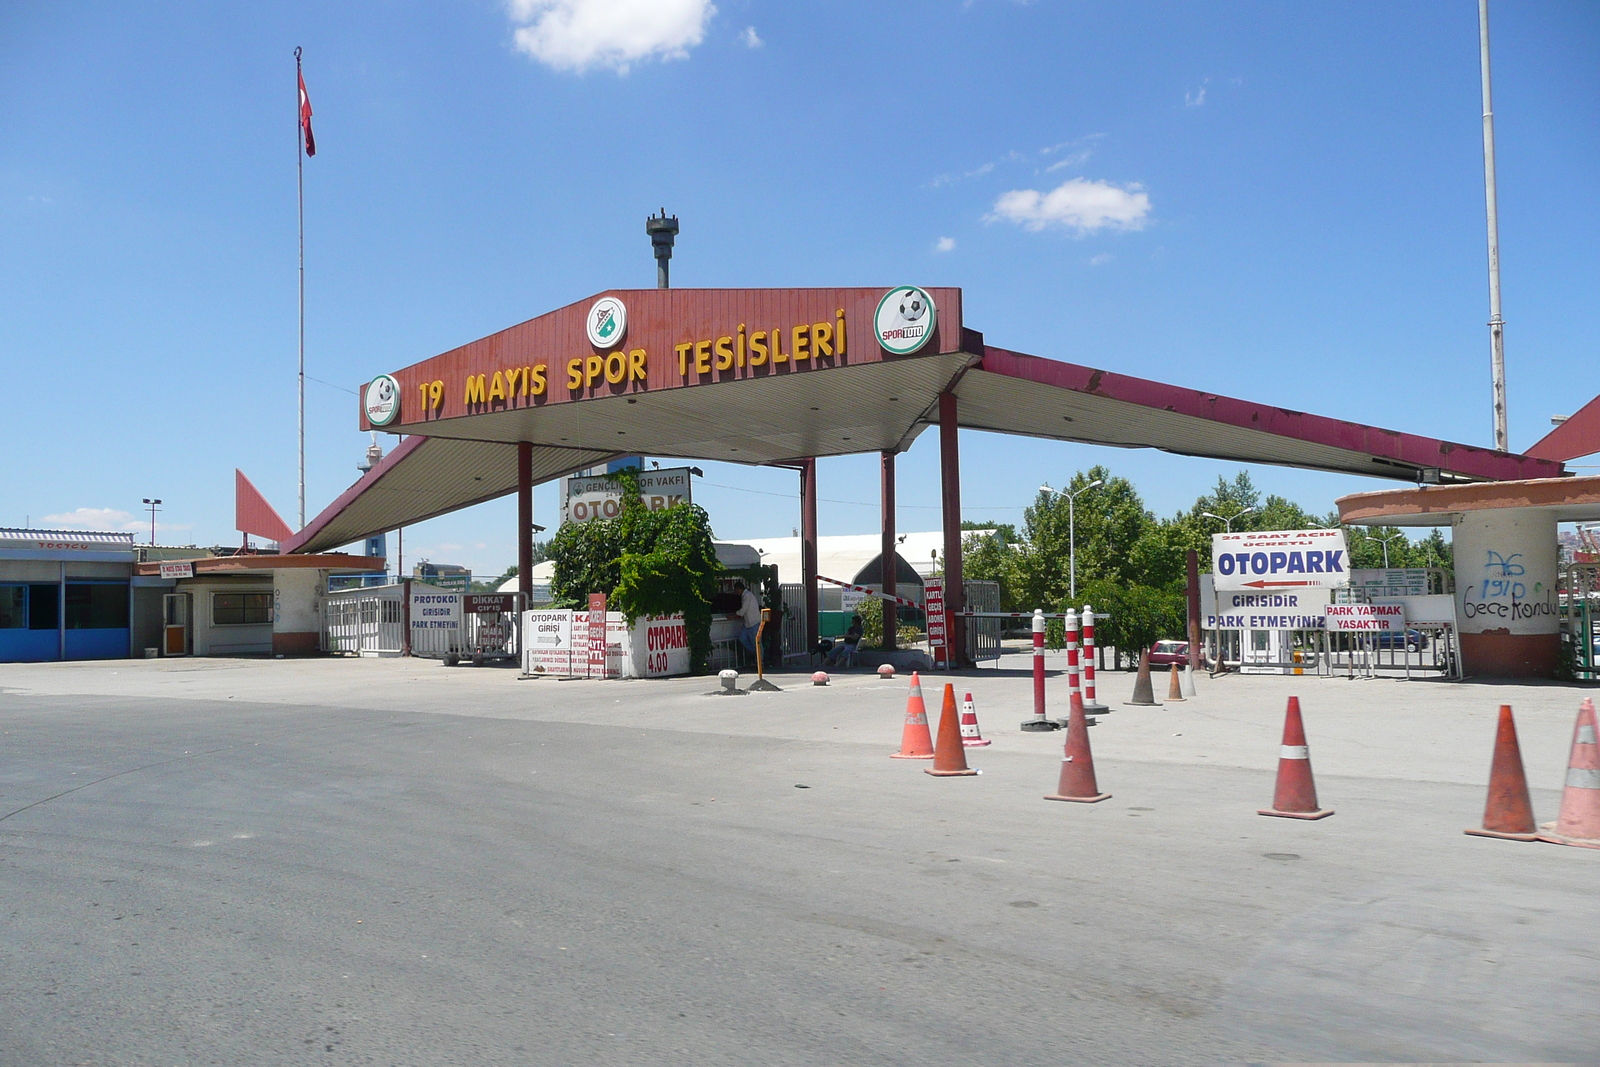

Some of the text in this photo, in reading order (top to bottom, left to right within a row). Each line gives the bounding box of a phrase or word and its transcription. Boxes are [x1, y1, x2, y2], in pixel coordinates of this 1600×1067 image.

[419, 308, 847, 411] 19 MAYIS SPOR TESİSLERİ
[656, 476, 684, 486] VAKFI
[1218, 550, 1344, 575] OTOPARK
[1327, 606, 1401, 616] PARK YAPMAK
[531, 614, 567, 622] OTOPARK
[1208, 615, 1325, 628] PARK ETMEYİNİZ
[538, 624, 560, 633] GİRİŞİ
[1337, 620, 1389, 629] YASAKTIR
